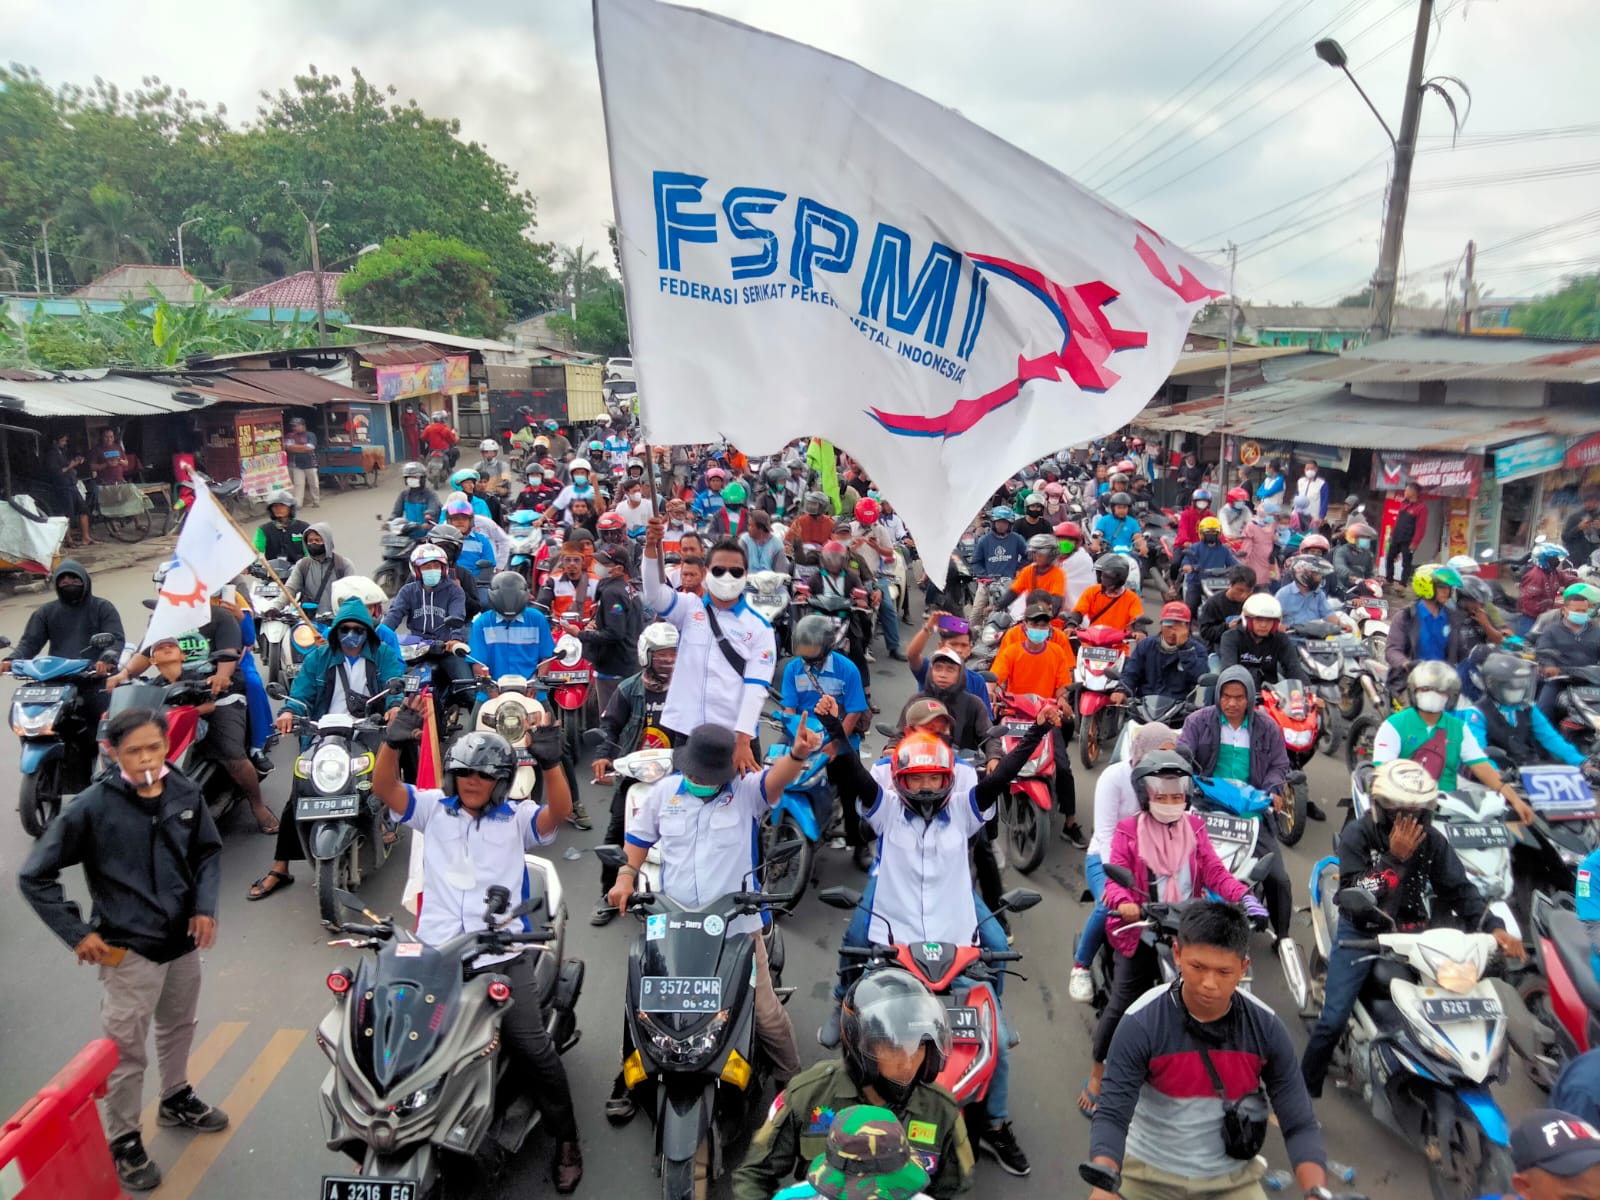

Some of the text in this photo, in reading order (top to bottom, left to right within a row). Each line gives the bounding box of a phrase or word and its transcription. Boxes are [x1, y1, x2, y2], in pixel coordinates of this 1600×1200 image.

[653, 171, 989, 361] FSPMI
[659, 277, 738, 304] FEDERASI
[743, 283, 786, 304] SERIKAT
[897, 341, 967, 384] INDONESIA
[1529, 774, 1585, 800] SPN
[302, 801, 309, 810] A
[644, 980, 720, 995] B 3572 CMR
[1426, 1001, 1435, 1015] A
[1441, 1000, 1472, 1014] 6267
[957, 1012, 972, 1026] JV
[1542, 1119, 1576, 1148] F1
[330, 1184, 410, 1200] A 3216 EG
